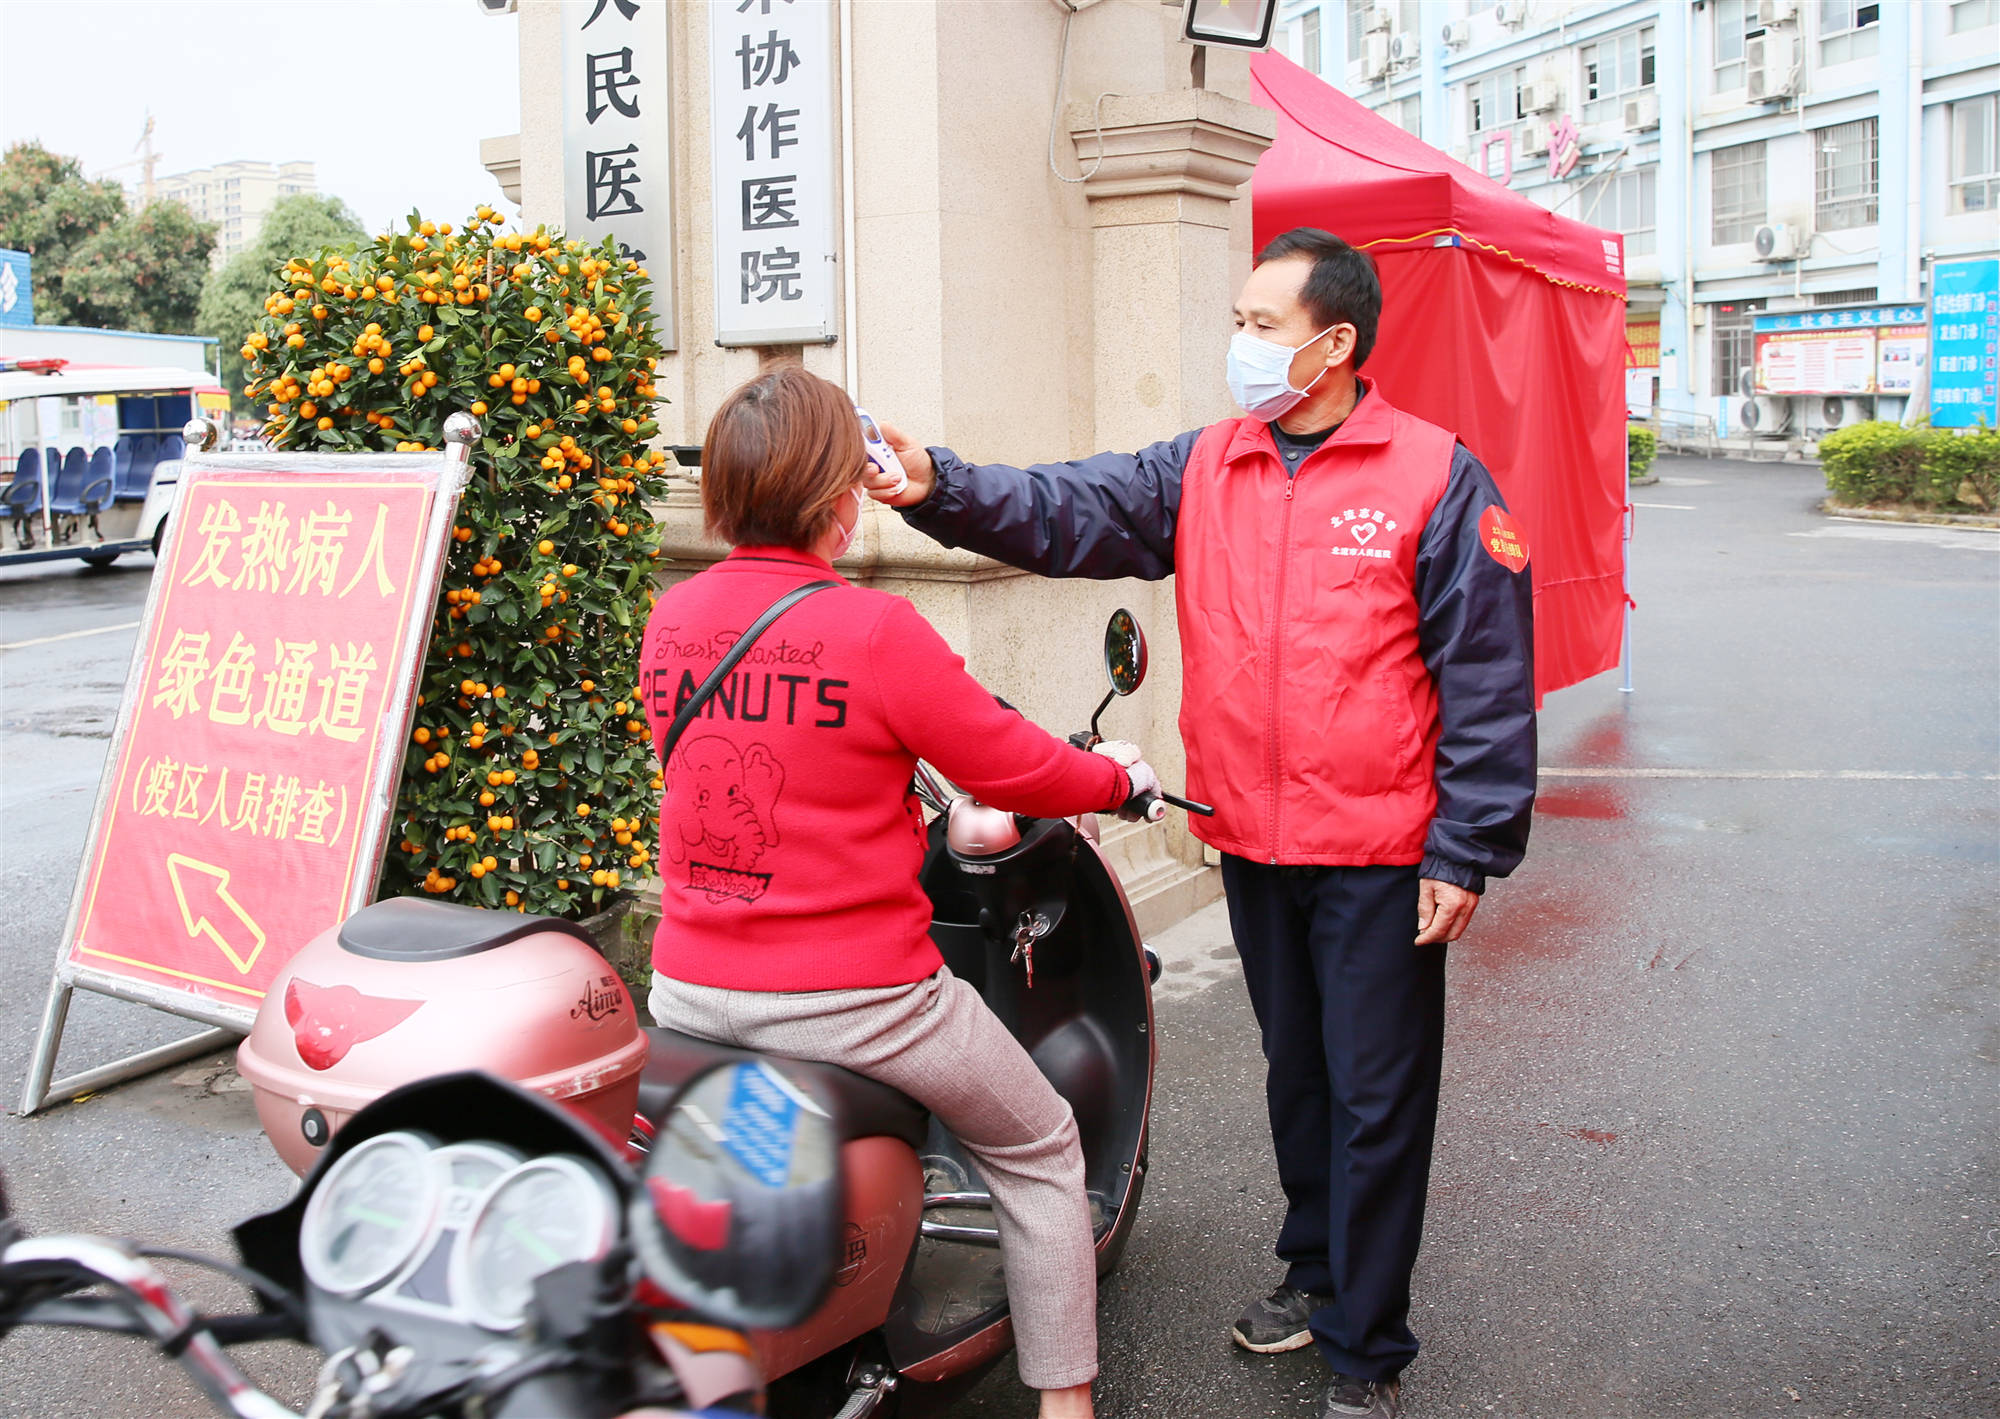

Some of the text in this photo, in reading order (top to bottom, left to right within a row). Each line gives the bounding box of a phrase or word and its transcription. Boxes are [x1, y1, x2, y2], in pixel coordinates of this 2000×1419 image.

[581, 0, 647, 270] 民医
[735, 0, 803, 305] 协作医院
[181, 499, 397, 599] 发热病人
[152, 627, 378, 743] 绿色通道
[655, 626, 721, 661] Fresh
[643, 668, 849, 729] PEANUTS
[133, 755, 348, 848] (疫区人员排查)
